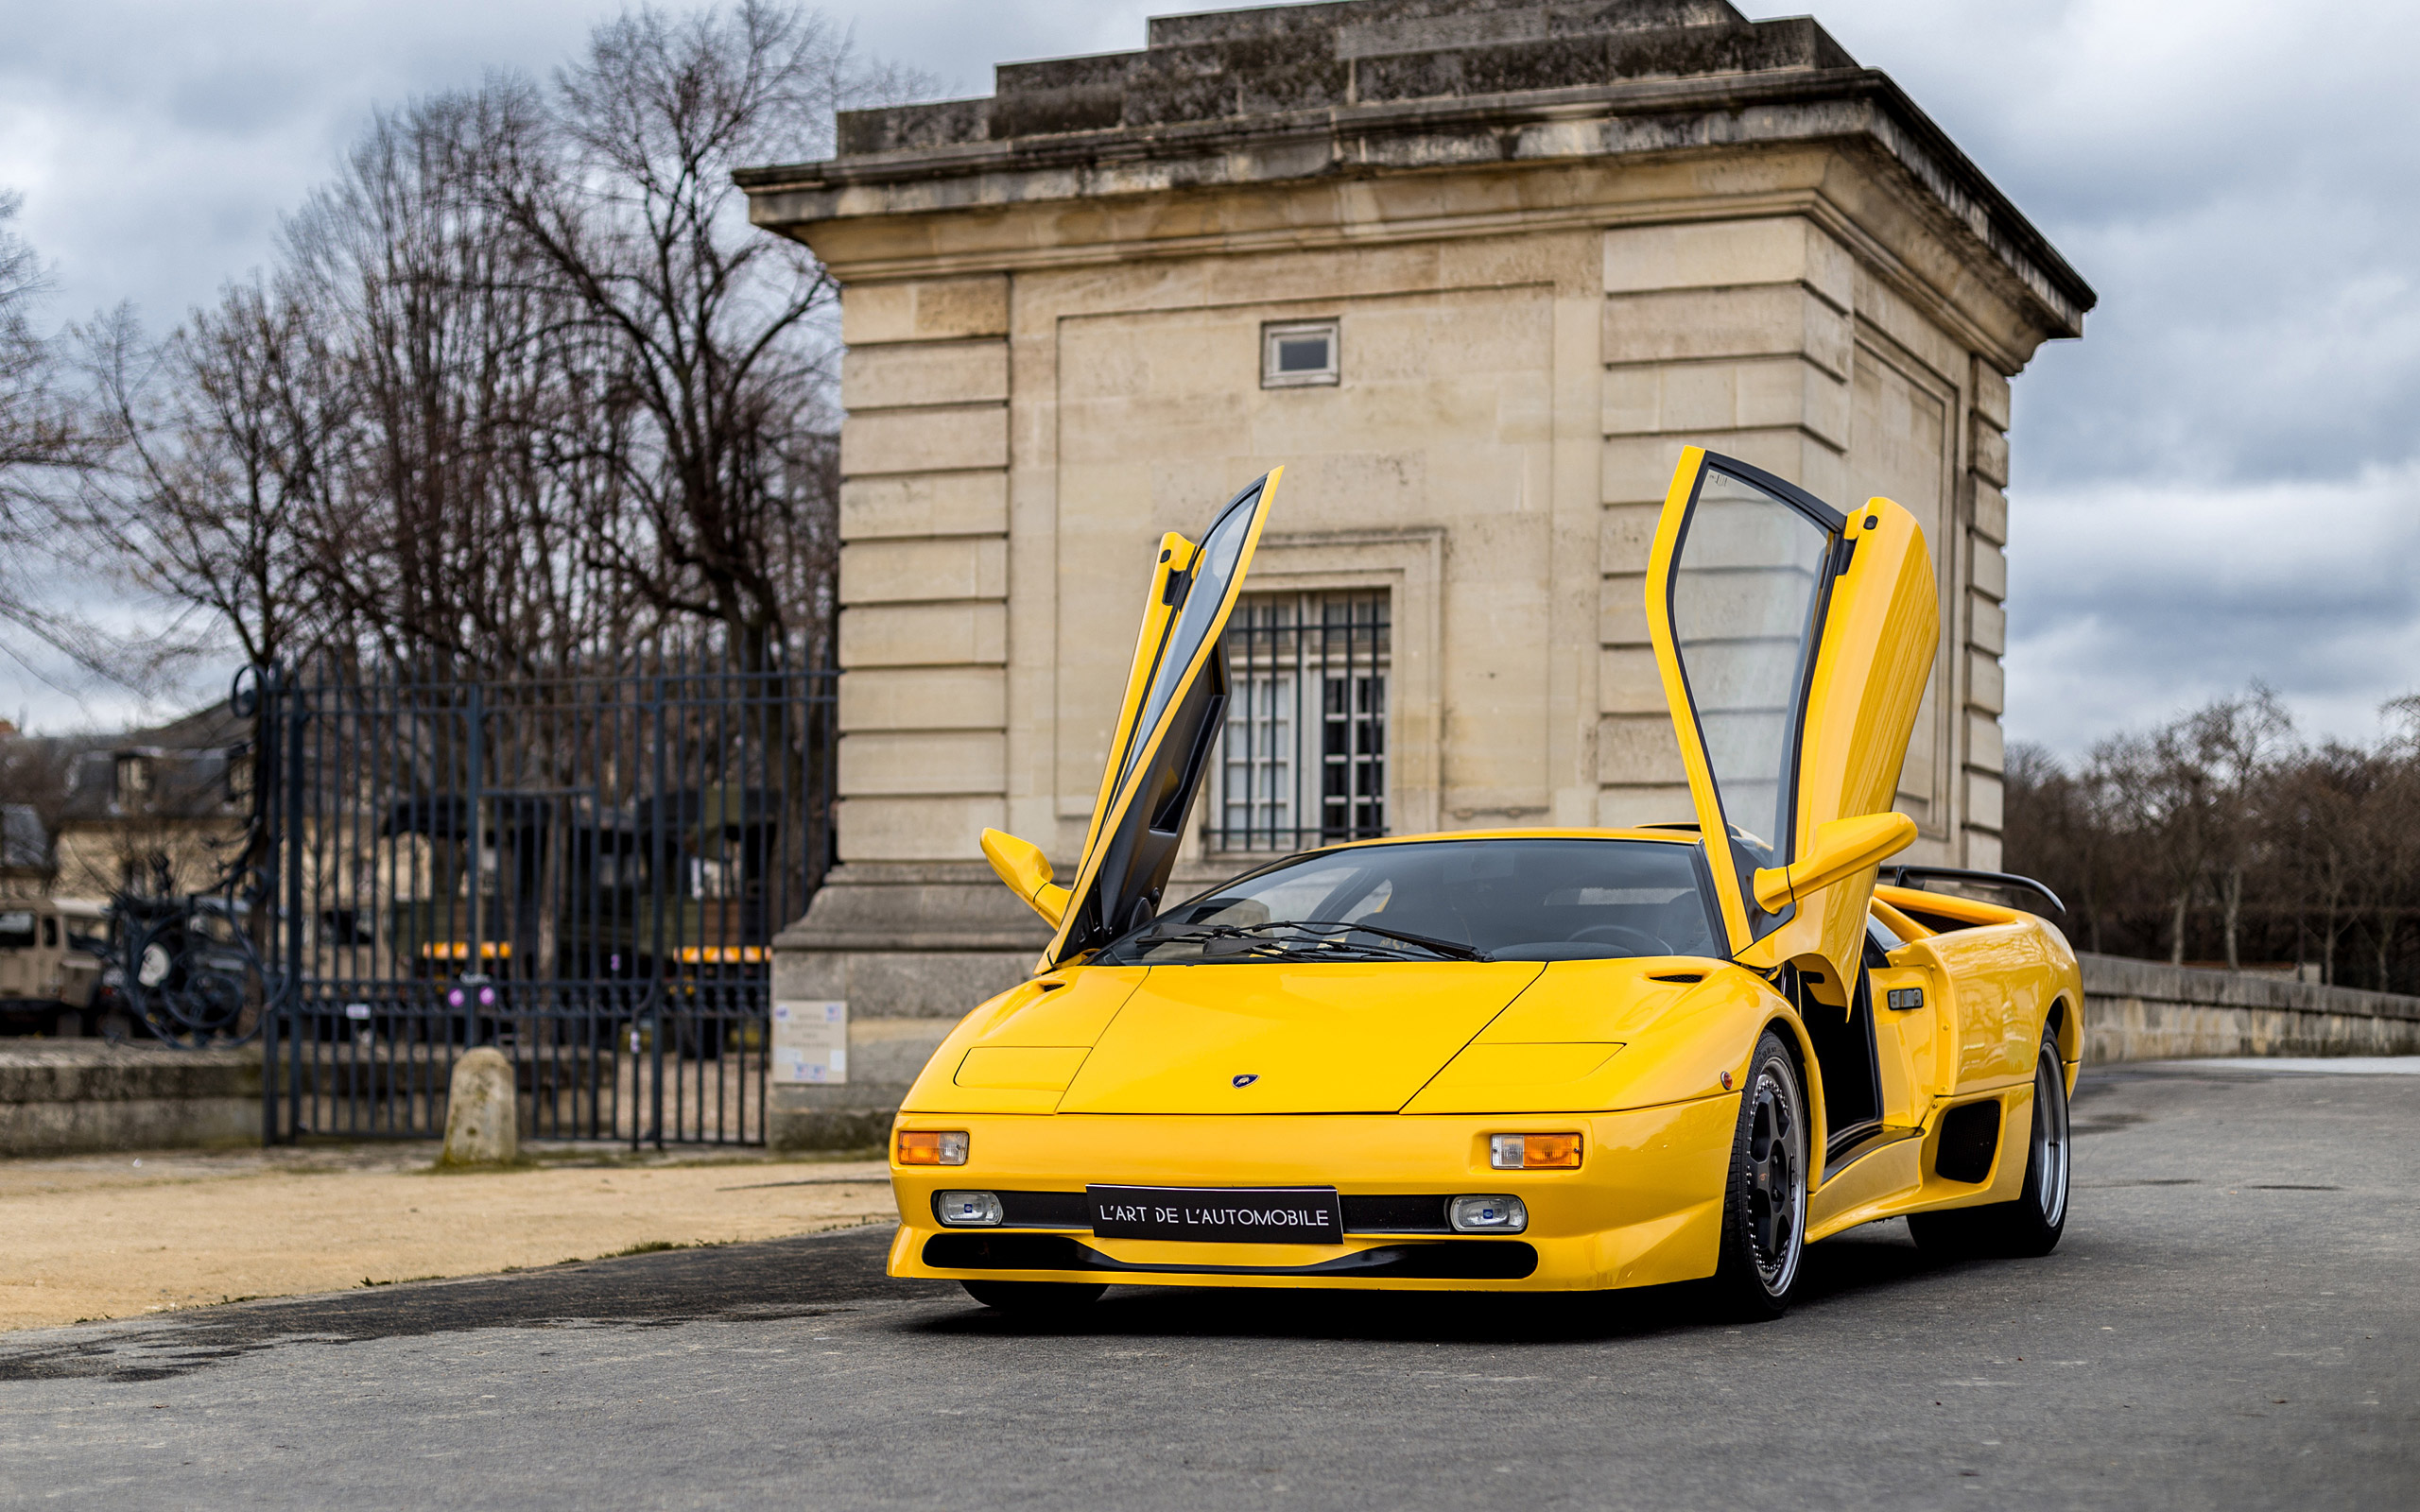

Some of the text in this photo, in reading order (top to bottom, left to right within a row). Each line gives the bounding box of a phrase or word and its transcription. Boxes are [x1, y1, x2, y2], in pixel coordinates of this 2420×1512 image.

[1099, 1204, 1330, 1227] L'ART DE L'AUTOMOBILE
